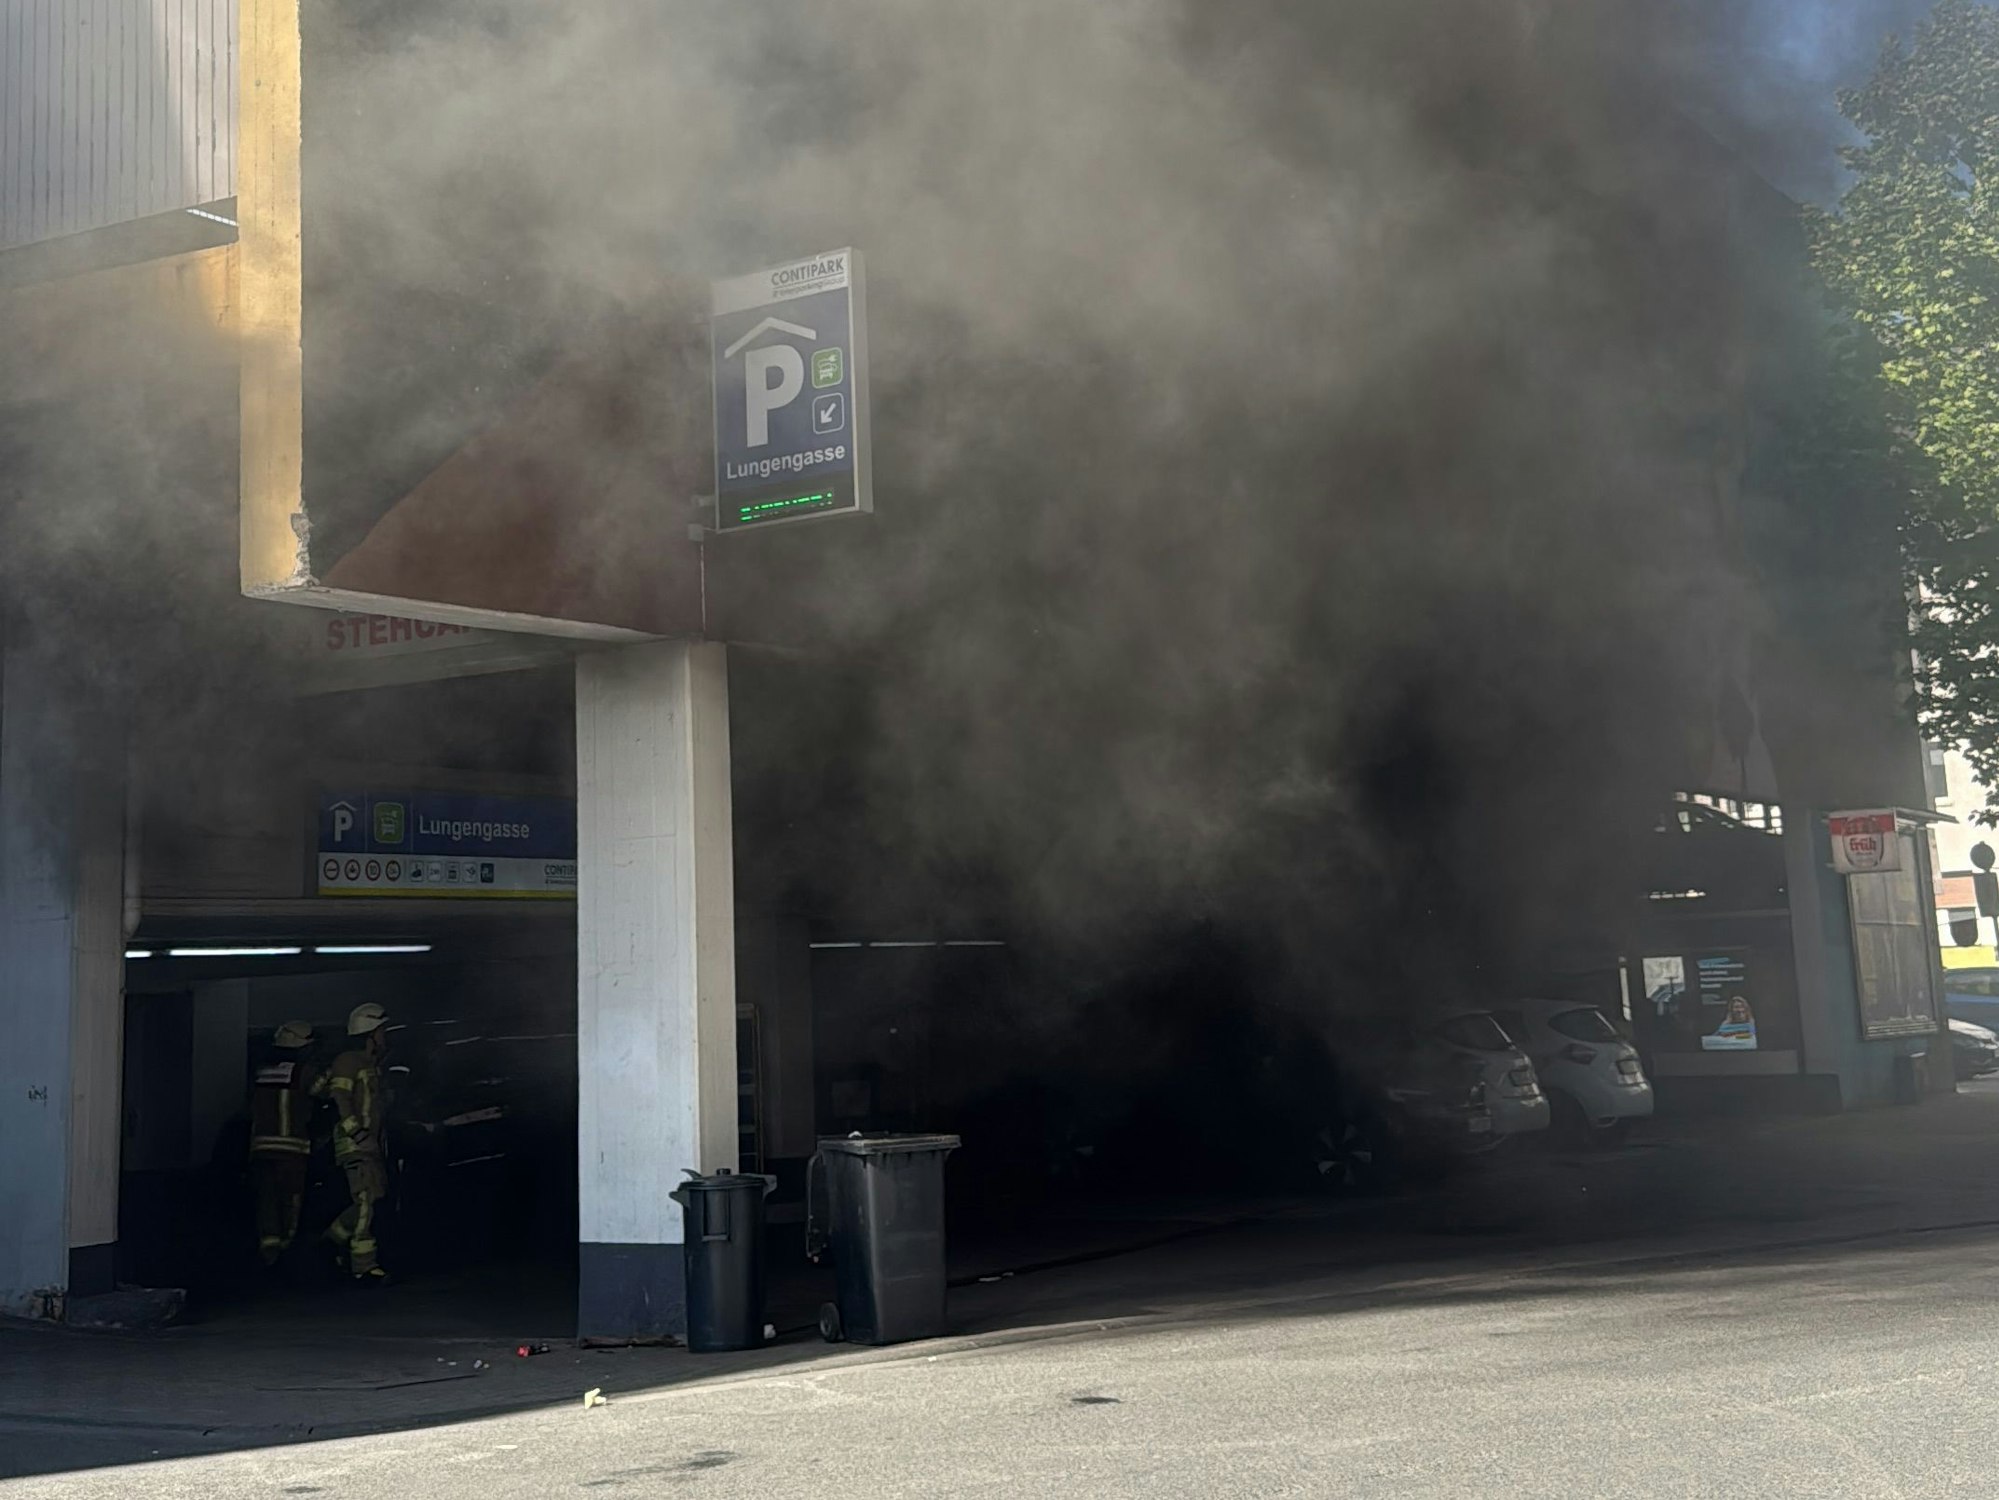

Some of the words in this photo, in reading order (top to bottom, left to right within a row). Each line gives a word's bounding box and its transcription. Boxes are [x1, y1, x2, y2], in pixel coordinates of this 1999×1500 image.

[771, 257, 844, 286] CONTIPARK
[745, 344, 805, 448] P
[726, 445, 846, 480] Lungengasse
[326, 613, 470, 650] STERC
[334, 809, 354, 842] P
[419, 815, 530, 842] Lungengasse
[544, 863, 578, 876] CONTIP
